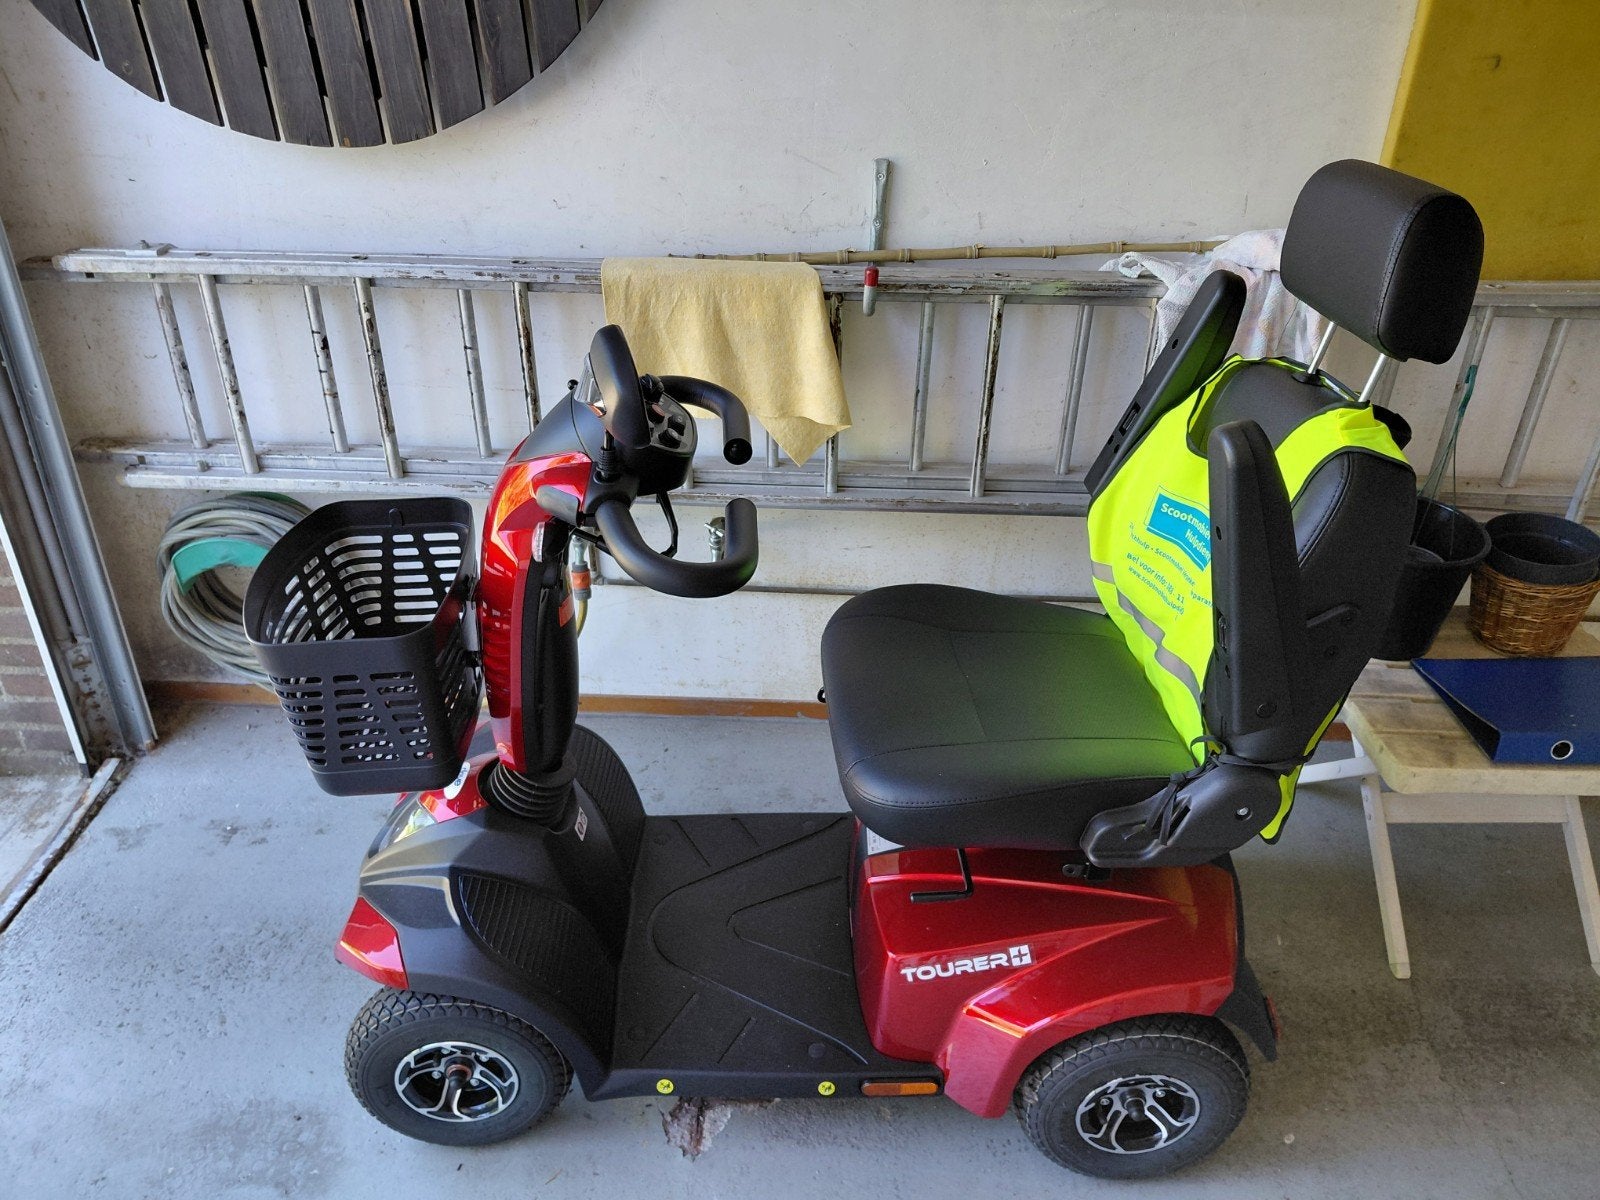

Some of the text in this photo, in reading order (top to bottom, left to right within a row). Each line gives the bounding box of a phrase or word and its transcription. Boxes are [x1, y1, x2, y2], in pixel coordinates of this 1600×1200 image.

[1160, 503, 1210, 540] Scootmobie
[1139, 562, 1155, 574] voor
[900, 953, 1010, 982] TOURER
